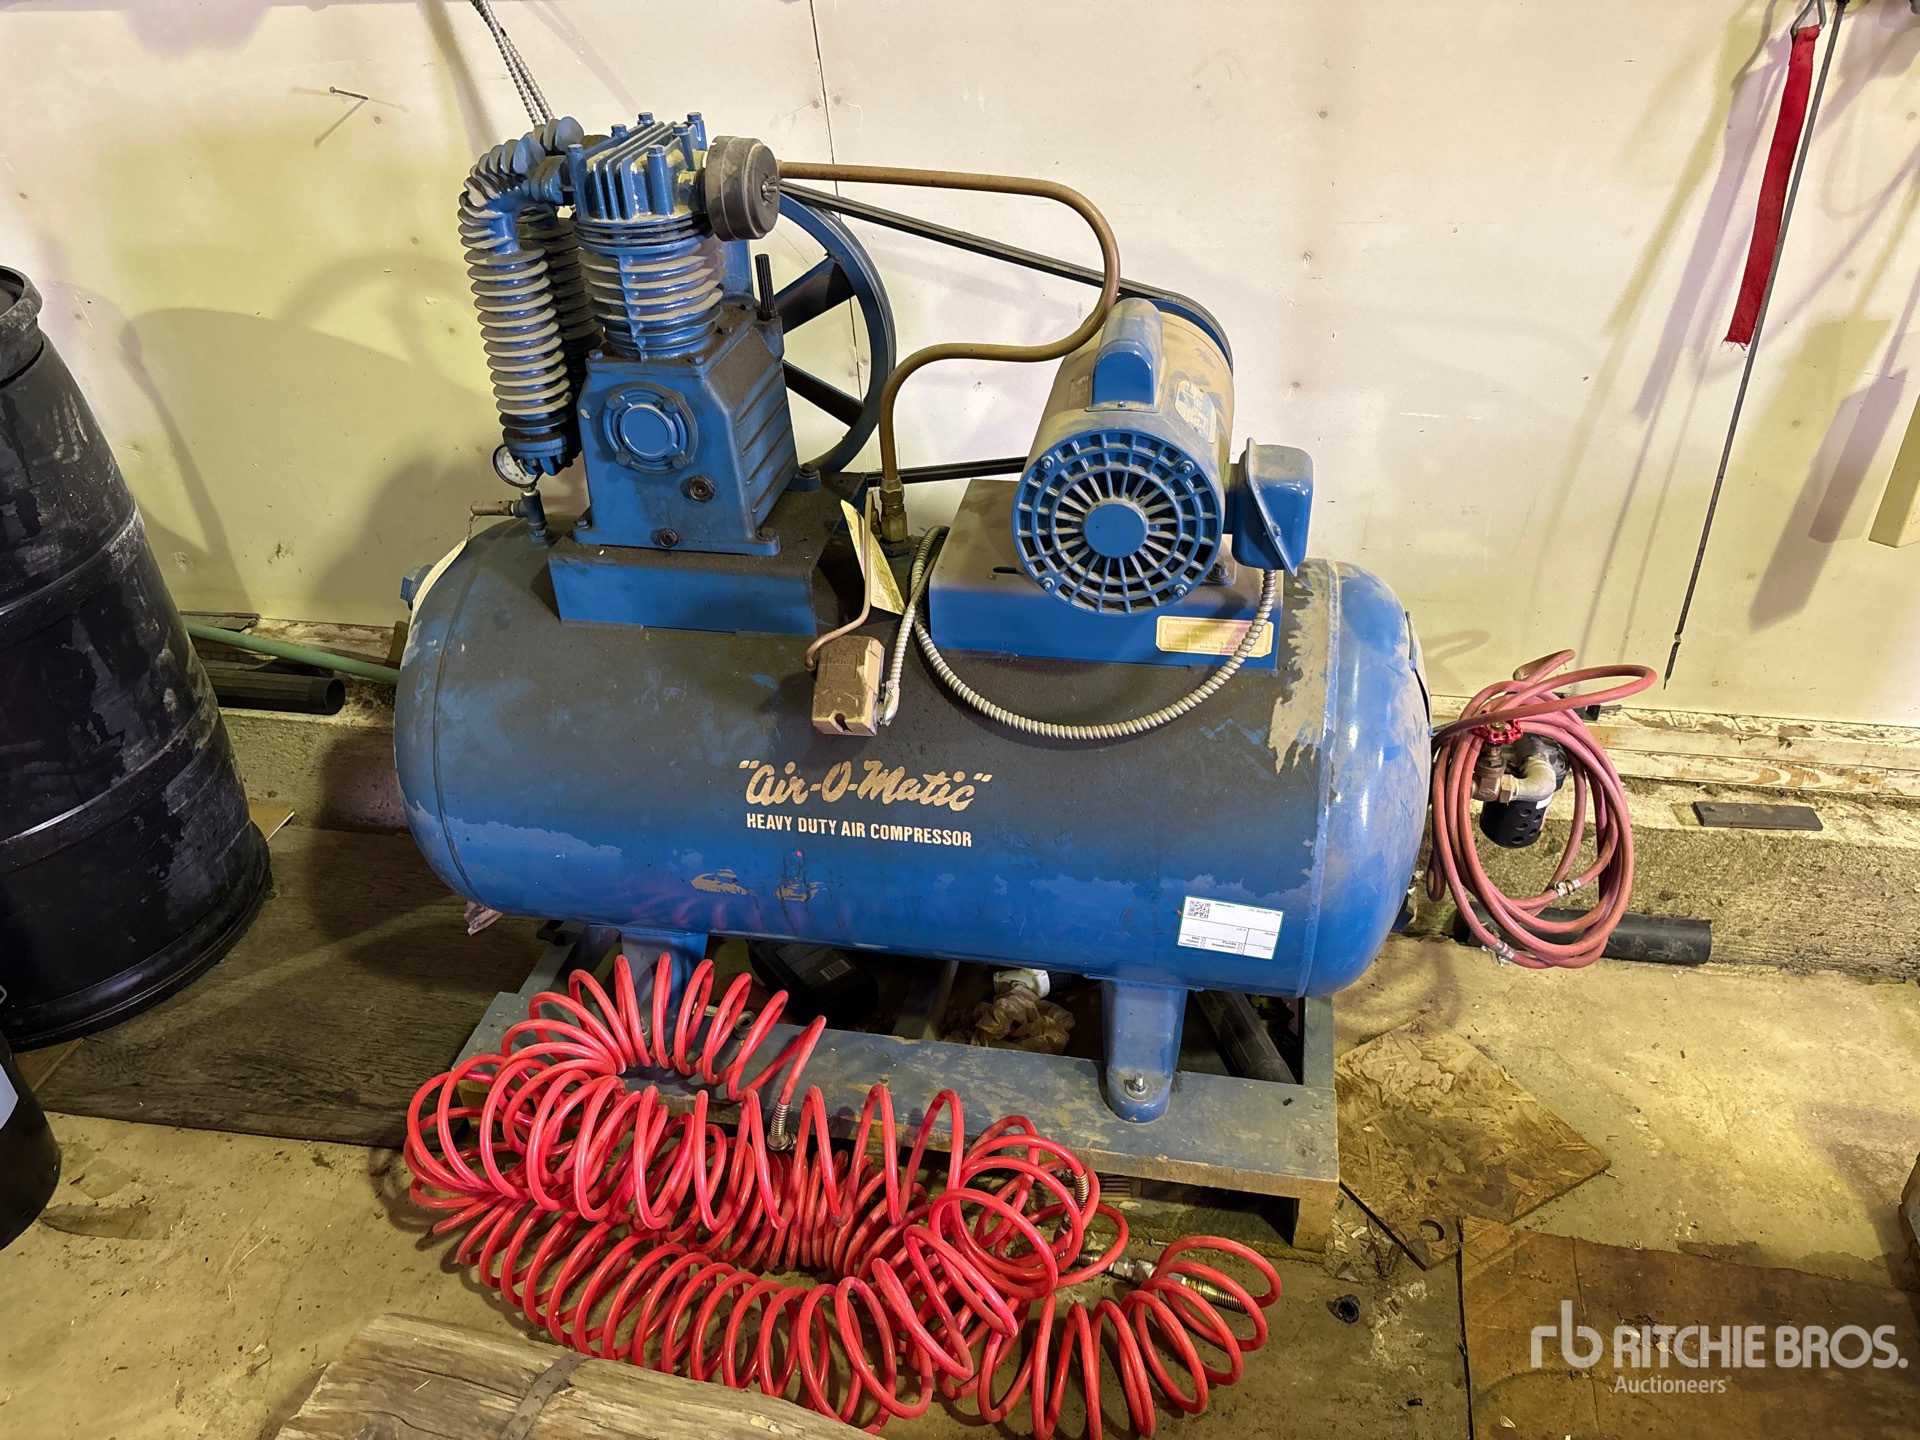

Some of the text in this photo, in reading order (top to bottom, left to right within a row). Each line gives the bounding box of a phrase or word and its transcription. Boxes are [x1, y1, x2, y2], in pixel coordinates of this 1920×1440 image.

[746, 812, 973, 848] HEAVY DUTY AIR COMPRESSOR
